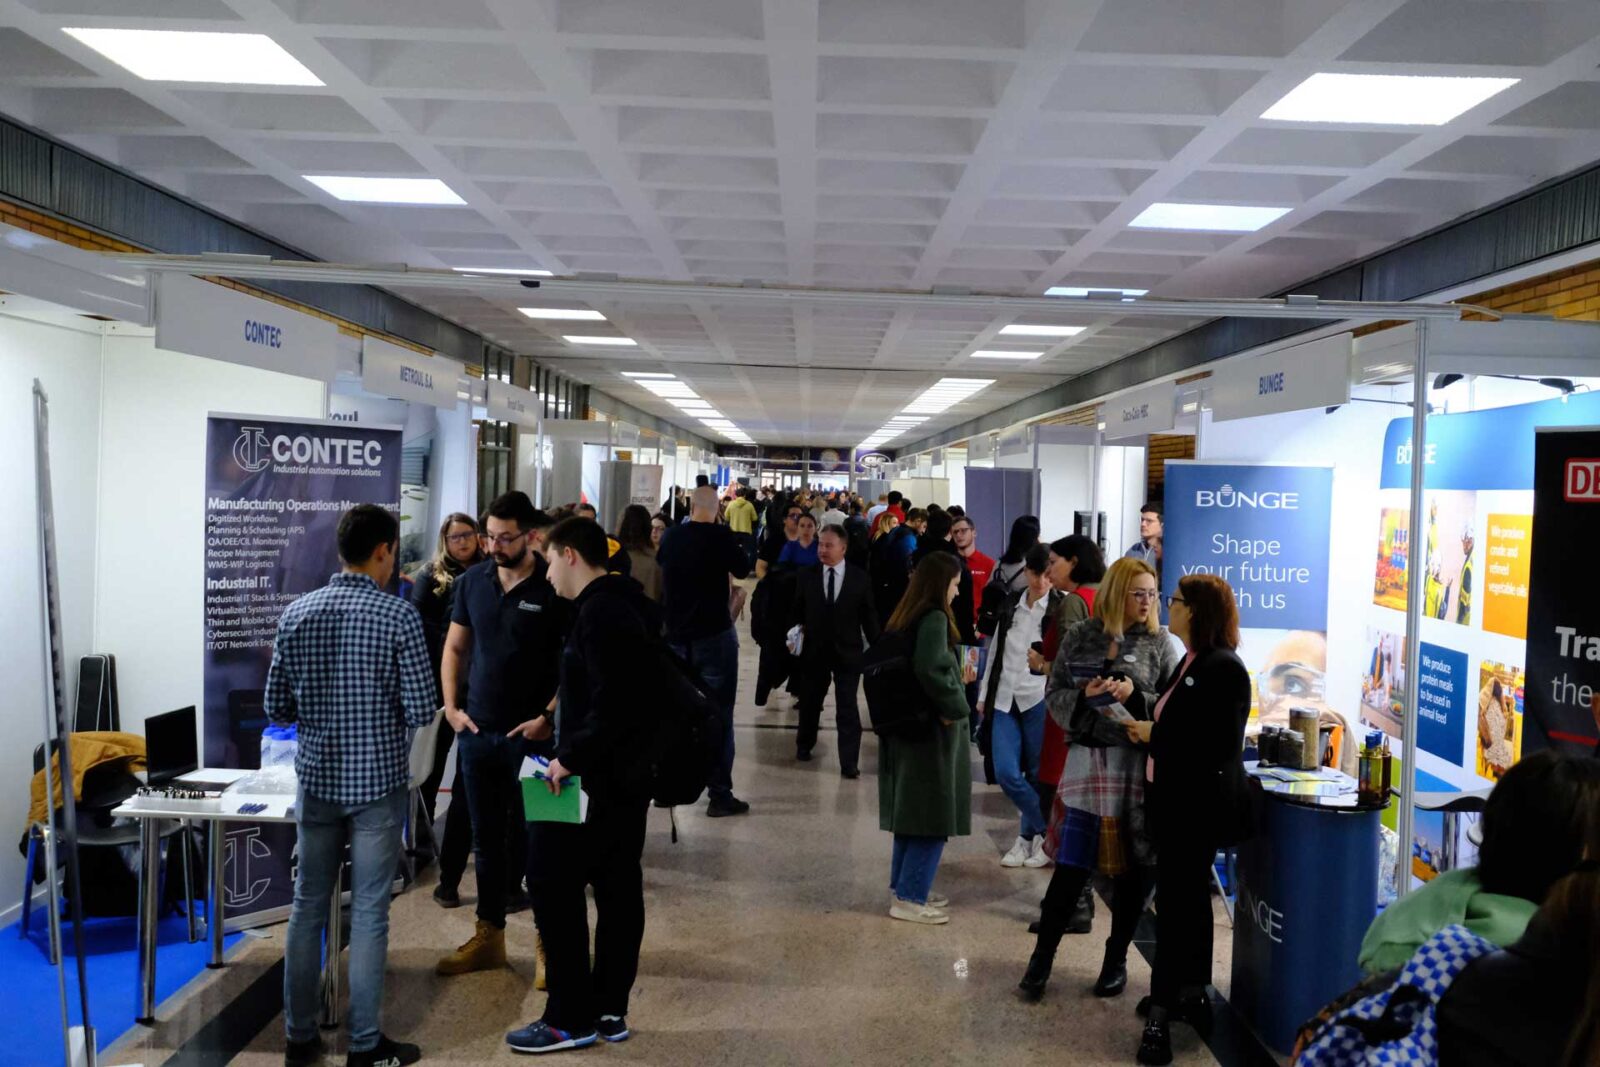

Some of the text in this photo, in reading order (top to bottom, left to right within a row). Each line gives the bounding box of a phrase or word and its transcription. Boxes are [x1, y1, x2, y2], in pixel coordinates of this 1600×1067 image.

[245, 320, 282, 349] CONTEC
[1259, 372, 1284, 395] BUNGE
[272, 435, 382, 467] CONTEC
[1396, 443, 1437, 465] BUE
[273, 464, 382, 478] Industrial automation solutions
[208, 497, 284, 513] Manufacturing
[286, 499, 339, 514] Operations
[1196, 489, 1299, 509] BUNGE
[208, 514, 278, 525] Digitized Workflows
[208, 526, 305, 536] Planning & Scheduling (APS)
[208, 537, 290, 548] QA/OEE/CIL Monitoring
[1211, 533, 1281, 559] Shape
[208, 549, 280, 559] Recipe Management
[208, 560, 274, 570] WMS-WIP Logistics
[1240, 561, 1310, 584] future
[207, 576, 272, 589] Industrial IT.
[207, 593, 242, 603] Industrial
[243, 593, 250, 602] IT
[251, 593, 268, 602] Stack
[269, 593, 276, 601] &
[276, 592, 301, 603] System
[1261, 593, 1286, 609] us
[207, 604, 247, 615] Virtualized
[247, 605, 272, 615] System
[208, 617, 225, 627] Thin
[226, 617, 240, 626] and
[241, 616, 265, 625] Mobile
[207, 628, 253, 639] Cybersecure
[207, 641, 228, 650] IT/OT
[229, 640, 259, 649] Network
[1423, 655, 1451, 674] We produce
[1421, 674, 1453, 692] protein meals
[1551, 672, 1593, 708] the
[1420, 689, 1451, 708] to be used in
[1419, 705, 1447, 724] animal feed
